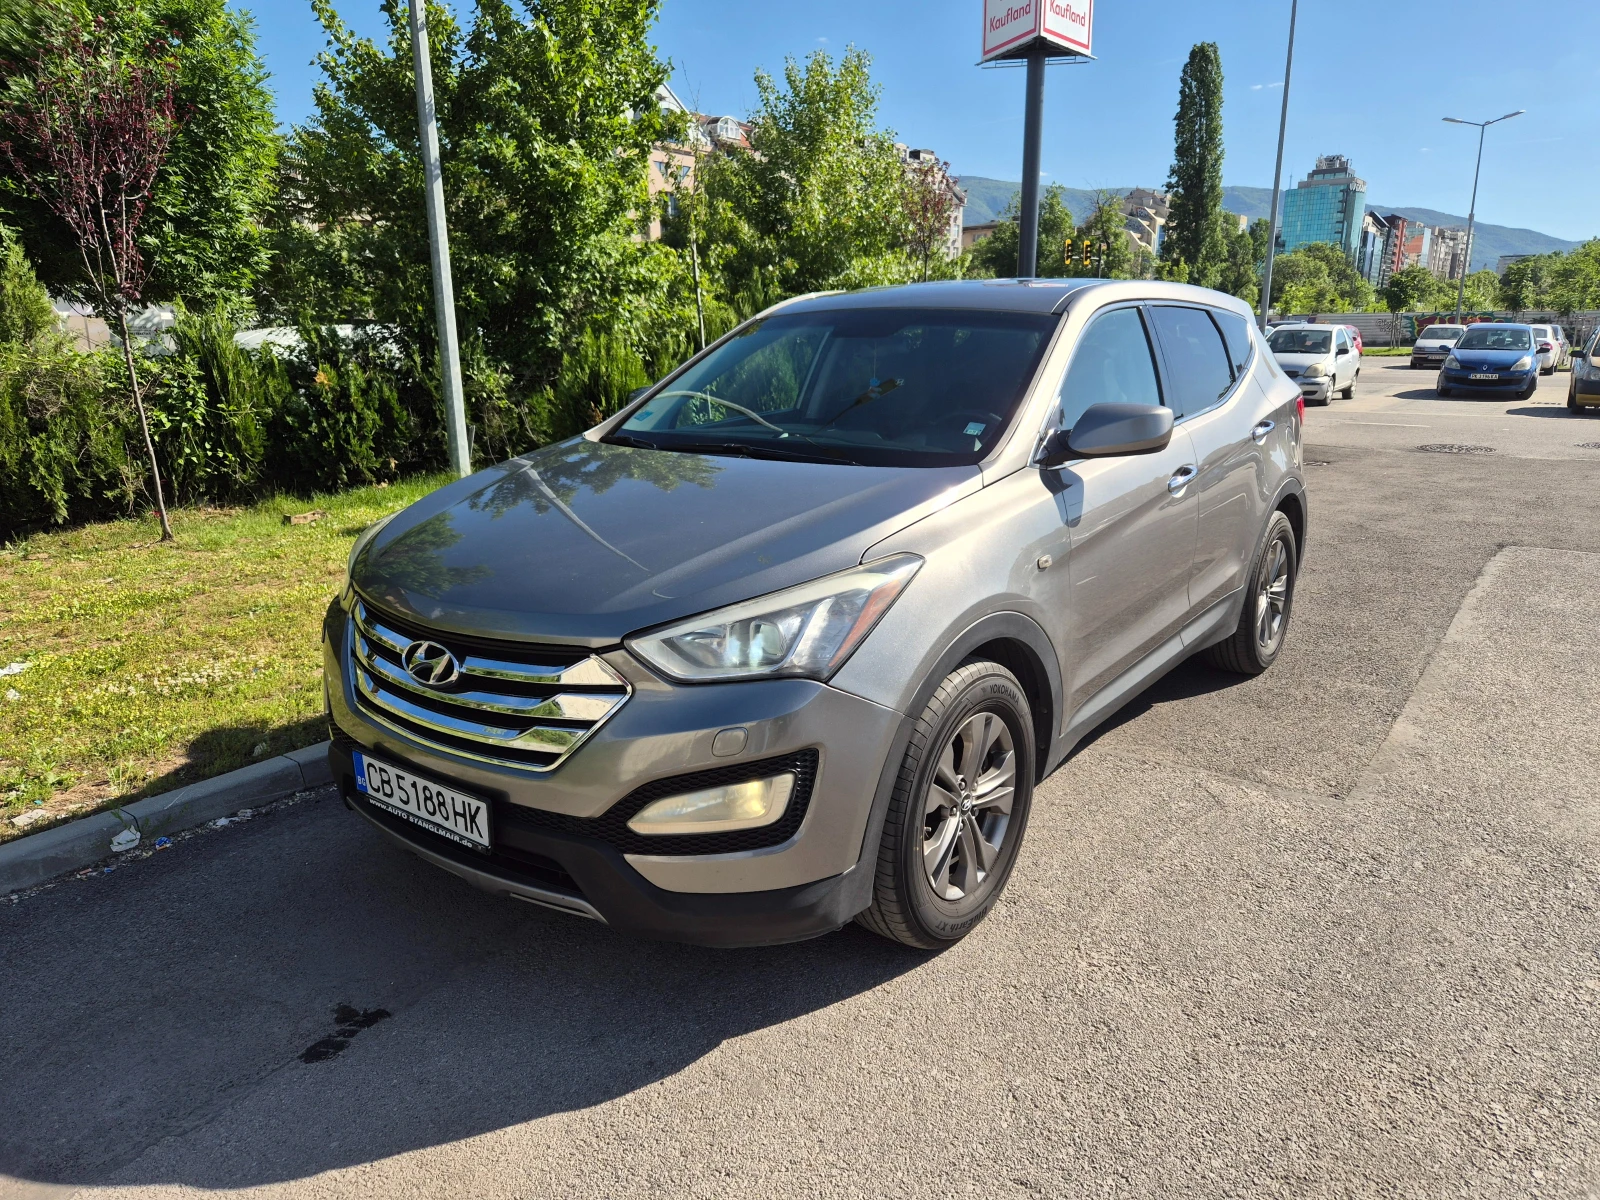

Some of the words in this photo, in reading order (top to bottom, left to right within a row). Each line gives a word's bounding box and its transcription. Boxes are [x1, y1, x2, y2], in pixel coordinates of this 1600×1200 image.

[989, 2, 1031, 33] Kaufland
[1049, 0, 1086, 27] Kaufland
[989, 683, 1020, 706] YOKOHAMA
